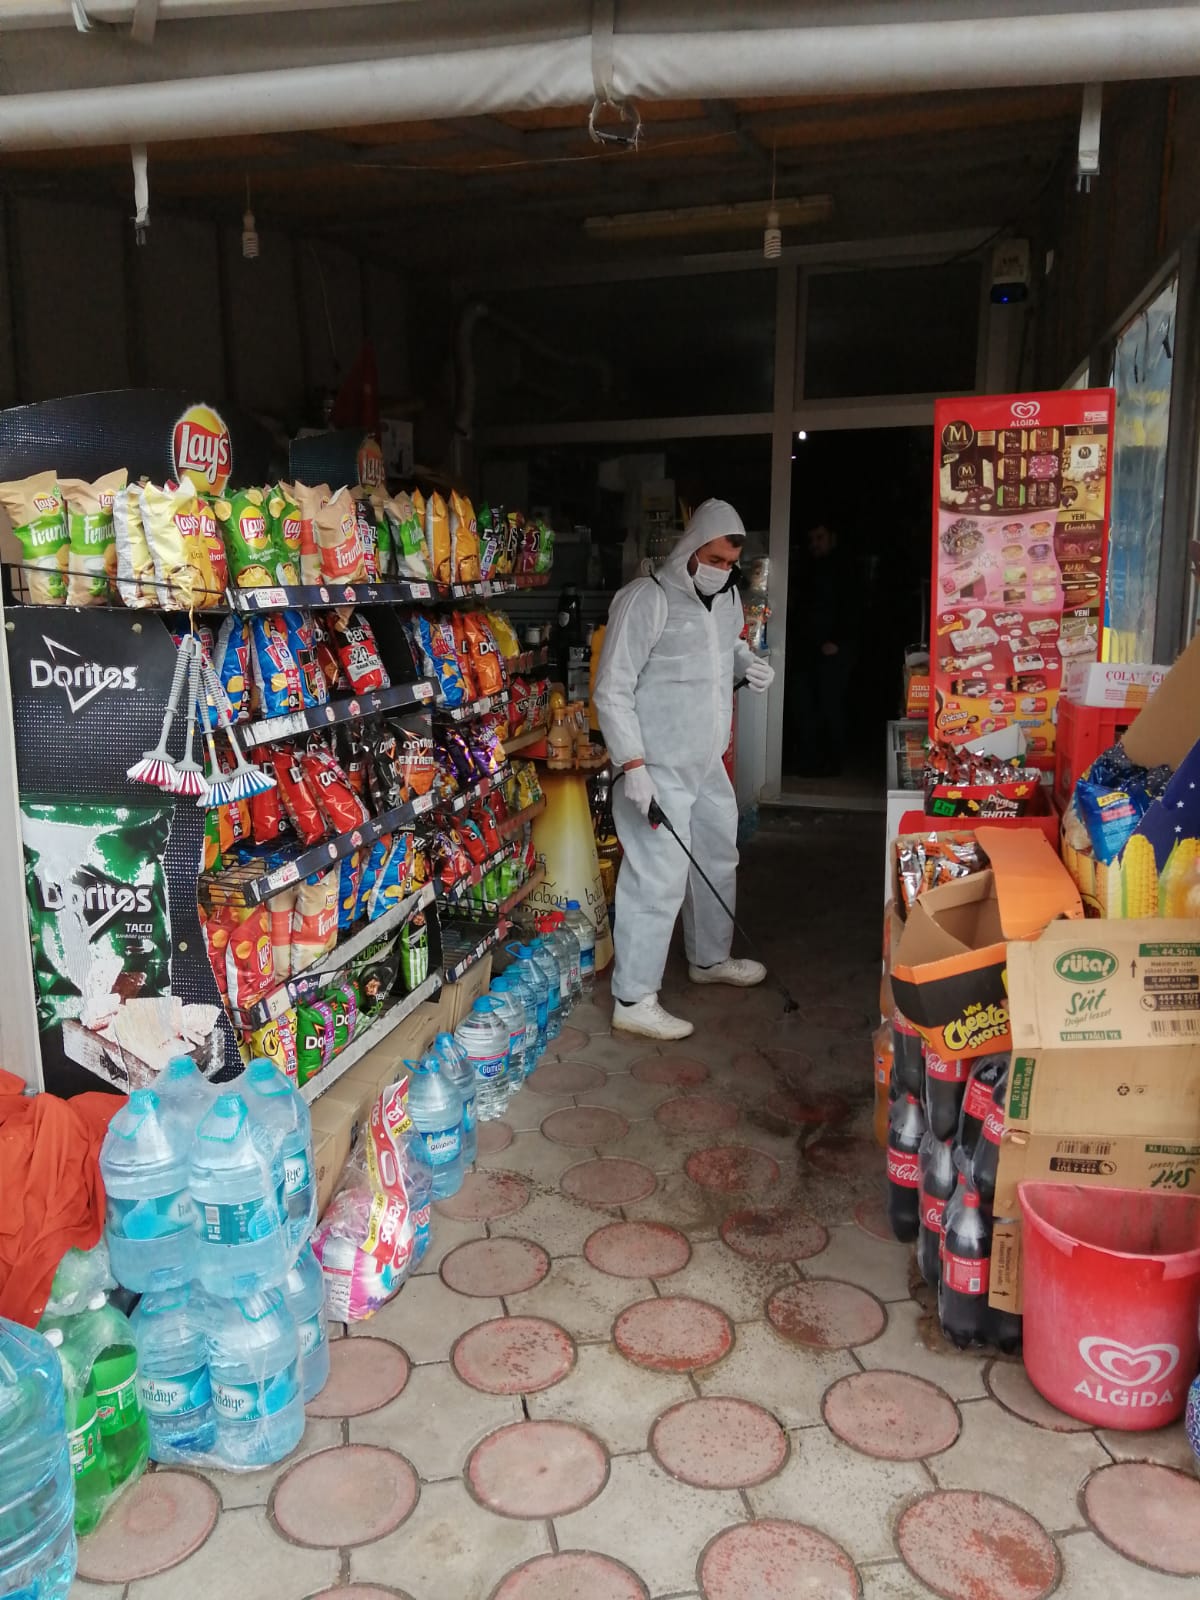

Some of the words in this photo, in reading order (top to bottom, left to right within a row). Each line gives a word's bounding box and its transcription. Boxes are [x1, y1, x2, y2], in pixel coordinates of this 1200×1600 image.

[178, 424, 229, 485] Lay's
[1074, 607, 1090, 617] YENİ
[29, 658, 138, 690] Doritos
[42, 879, 153, 913] Doritos
[125, 922, 153, 934] TACO
[1061, 954, 1113, 978] sütaş
[1065, 988, 1107, 1015] Süt
[943, 1003, 1009, 1050] Cheeto
[968, 1023, 1008, 1049] SHOTS
[1151, 1167, 1197, 1189] Süt
